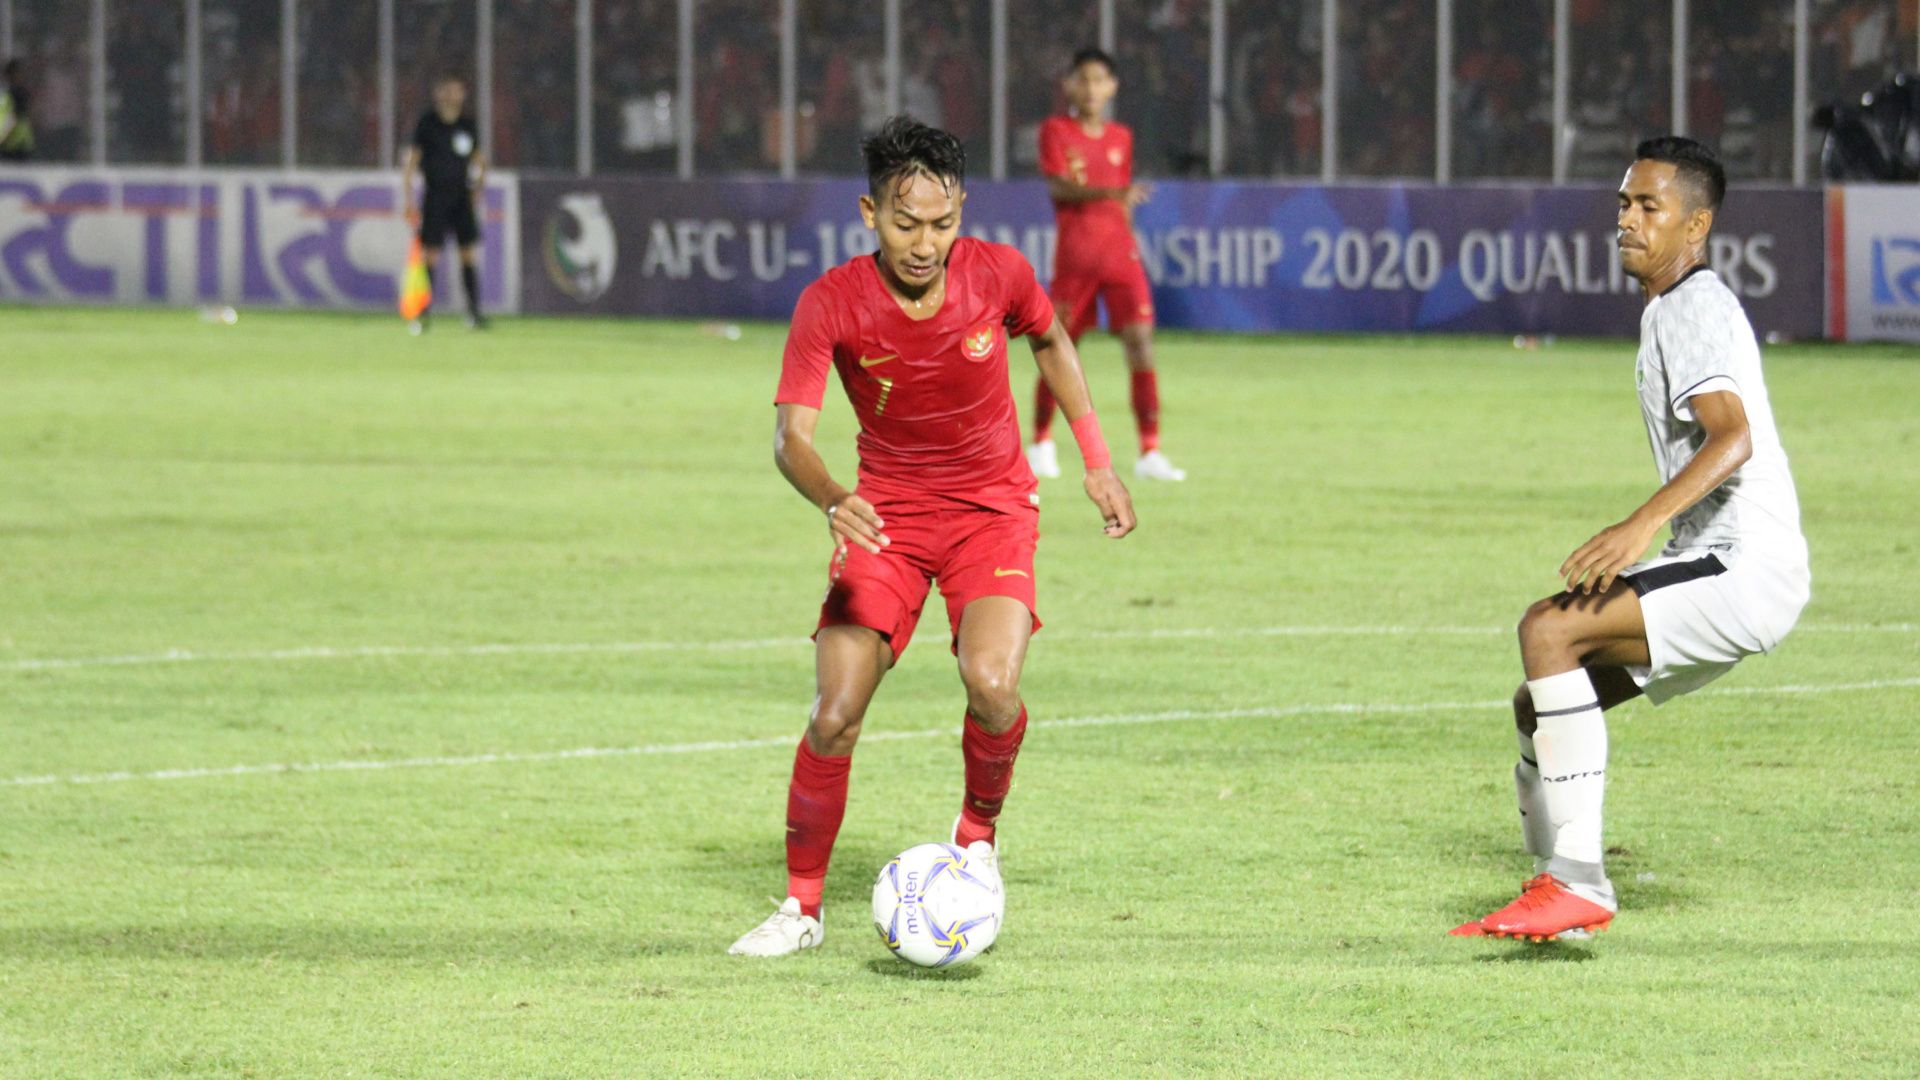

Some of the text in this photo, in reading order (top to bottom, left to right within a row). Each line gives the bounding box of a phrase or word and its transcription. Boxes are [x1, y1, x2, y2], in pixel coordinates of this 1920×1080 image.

[641, 219, 737, 280] AFC
[1303, 229, 1442, 290] 2020
[1459, 229, 1778, 301] QUALIRS
[1543, 769, 1606, 783] narro
[903, 871, 919, 934] molten
